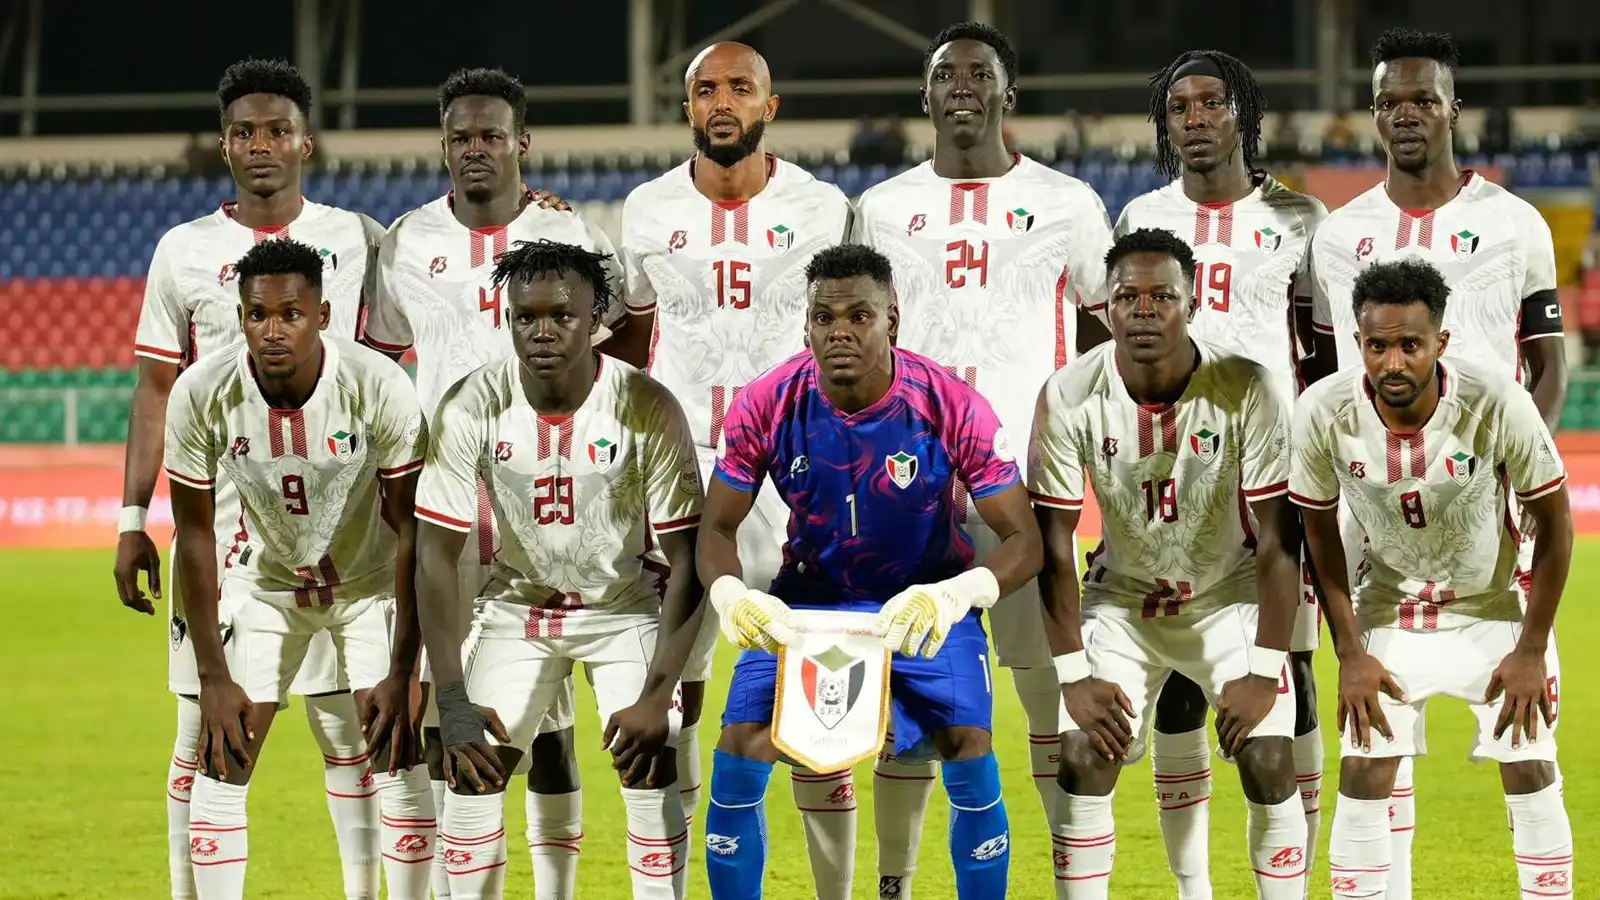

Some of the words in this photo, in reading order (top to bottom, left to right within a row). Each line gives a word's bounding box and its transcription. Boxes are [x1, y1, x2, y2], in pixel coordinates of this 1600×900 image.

[712, 259, 751, 309] 15
[946, 239, 989, 289] 24
[479, 284, 501, 329] 4
[1194, 262, 1231, 312] 19
[1545, 304, 1561, 318] C
[281, 474, 309, 515] 9
[534, 475, 574, 525] 23
[846, 493, 859, 538] 1
[1141, 478, 1179, 523] 18
[1400, 490, 1427, 529] 8
[978, 653, 991, 694] 1
